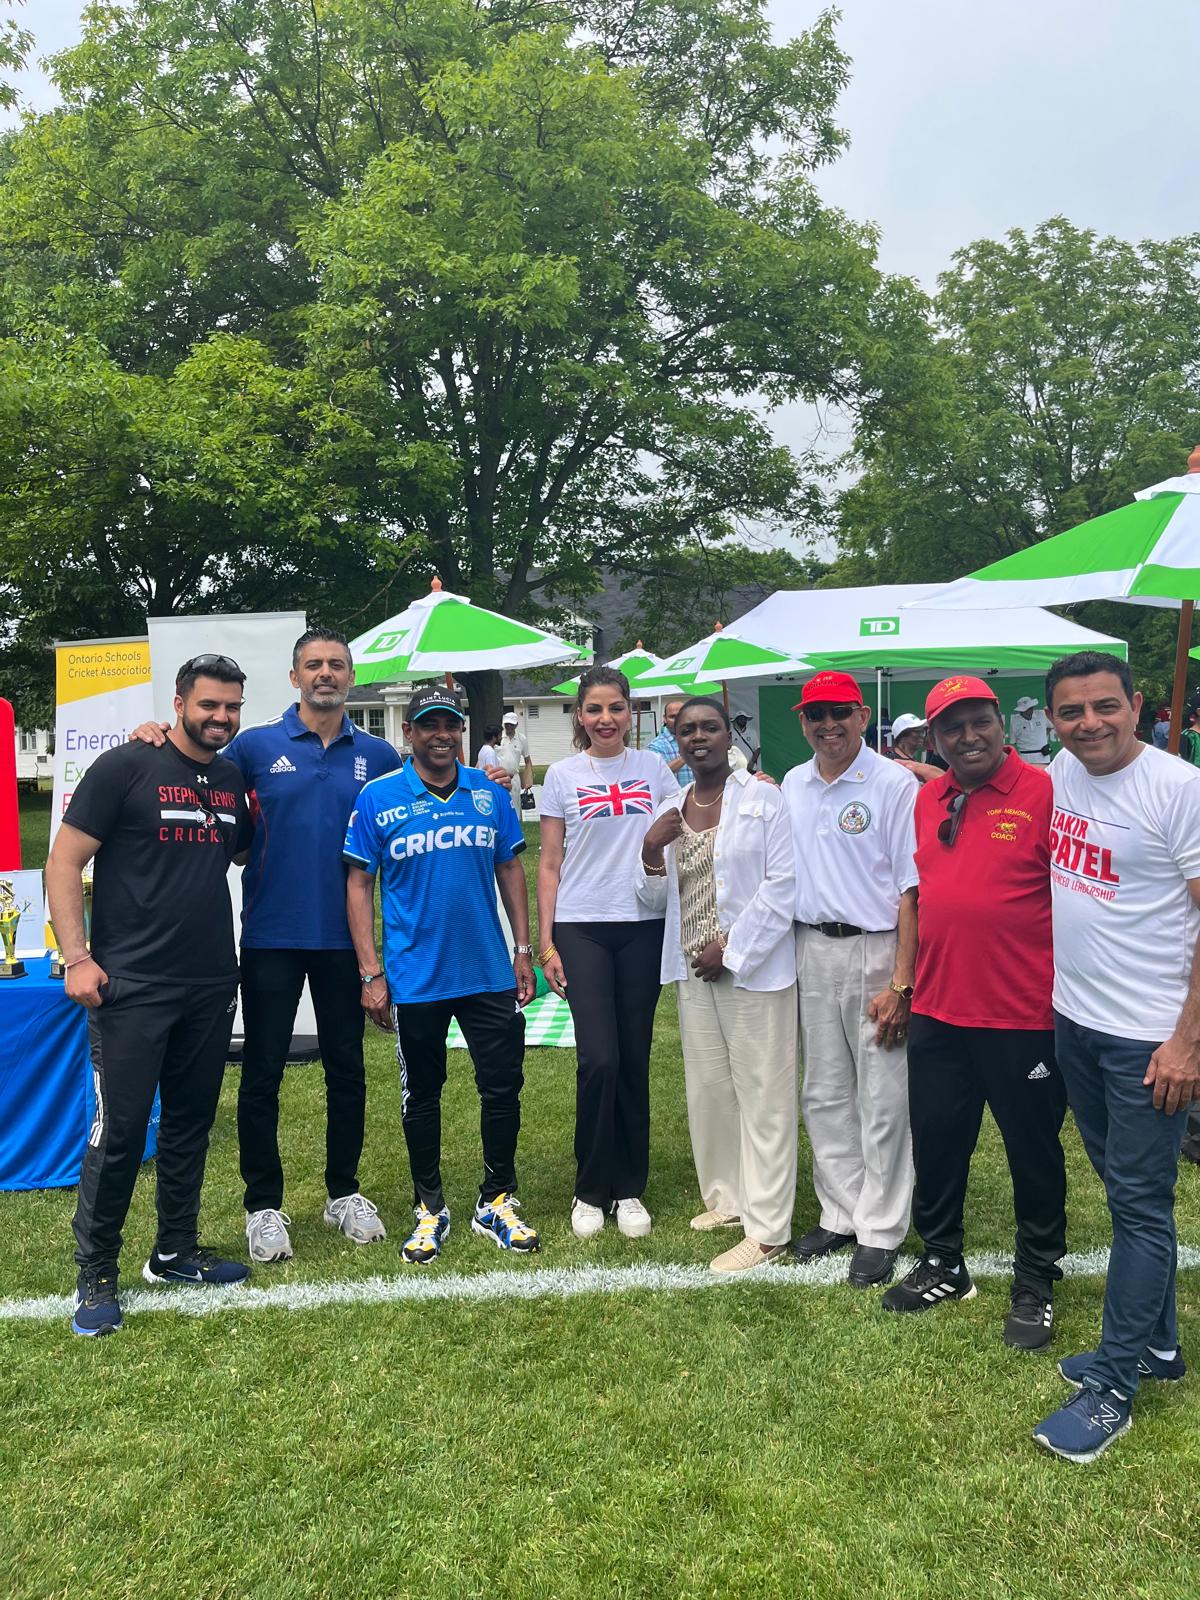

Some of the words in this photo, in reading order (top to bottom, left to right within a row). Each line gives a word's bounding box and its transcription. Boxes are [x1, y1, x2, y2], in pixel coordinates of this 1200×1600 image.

[863, 620, 896, 633] TD
[375, 634, 403, 649] TD
[68, 654, 102, 664] Ontario
[105, 651, 141, 662] Schools
[68, 668, 98, 678] Cricket
[66, 729, 128, 750] Energi
[269, 765, 297, 774] adidas
[209, 790, 236, 808] LEWIS
[375, 805, 408, 827] UTC
[1004, 808, 1032, 821] MEMORIAL
[1052, 810, 1088, 839] ZAKIR
[991, 832, 1016, 841] COACH
[1049, 829, 1120, 883] PATEL
[1071, 880, 1116, 900] LEADERSHIP
